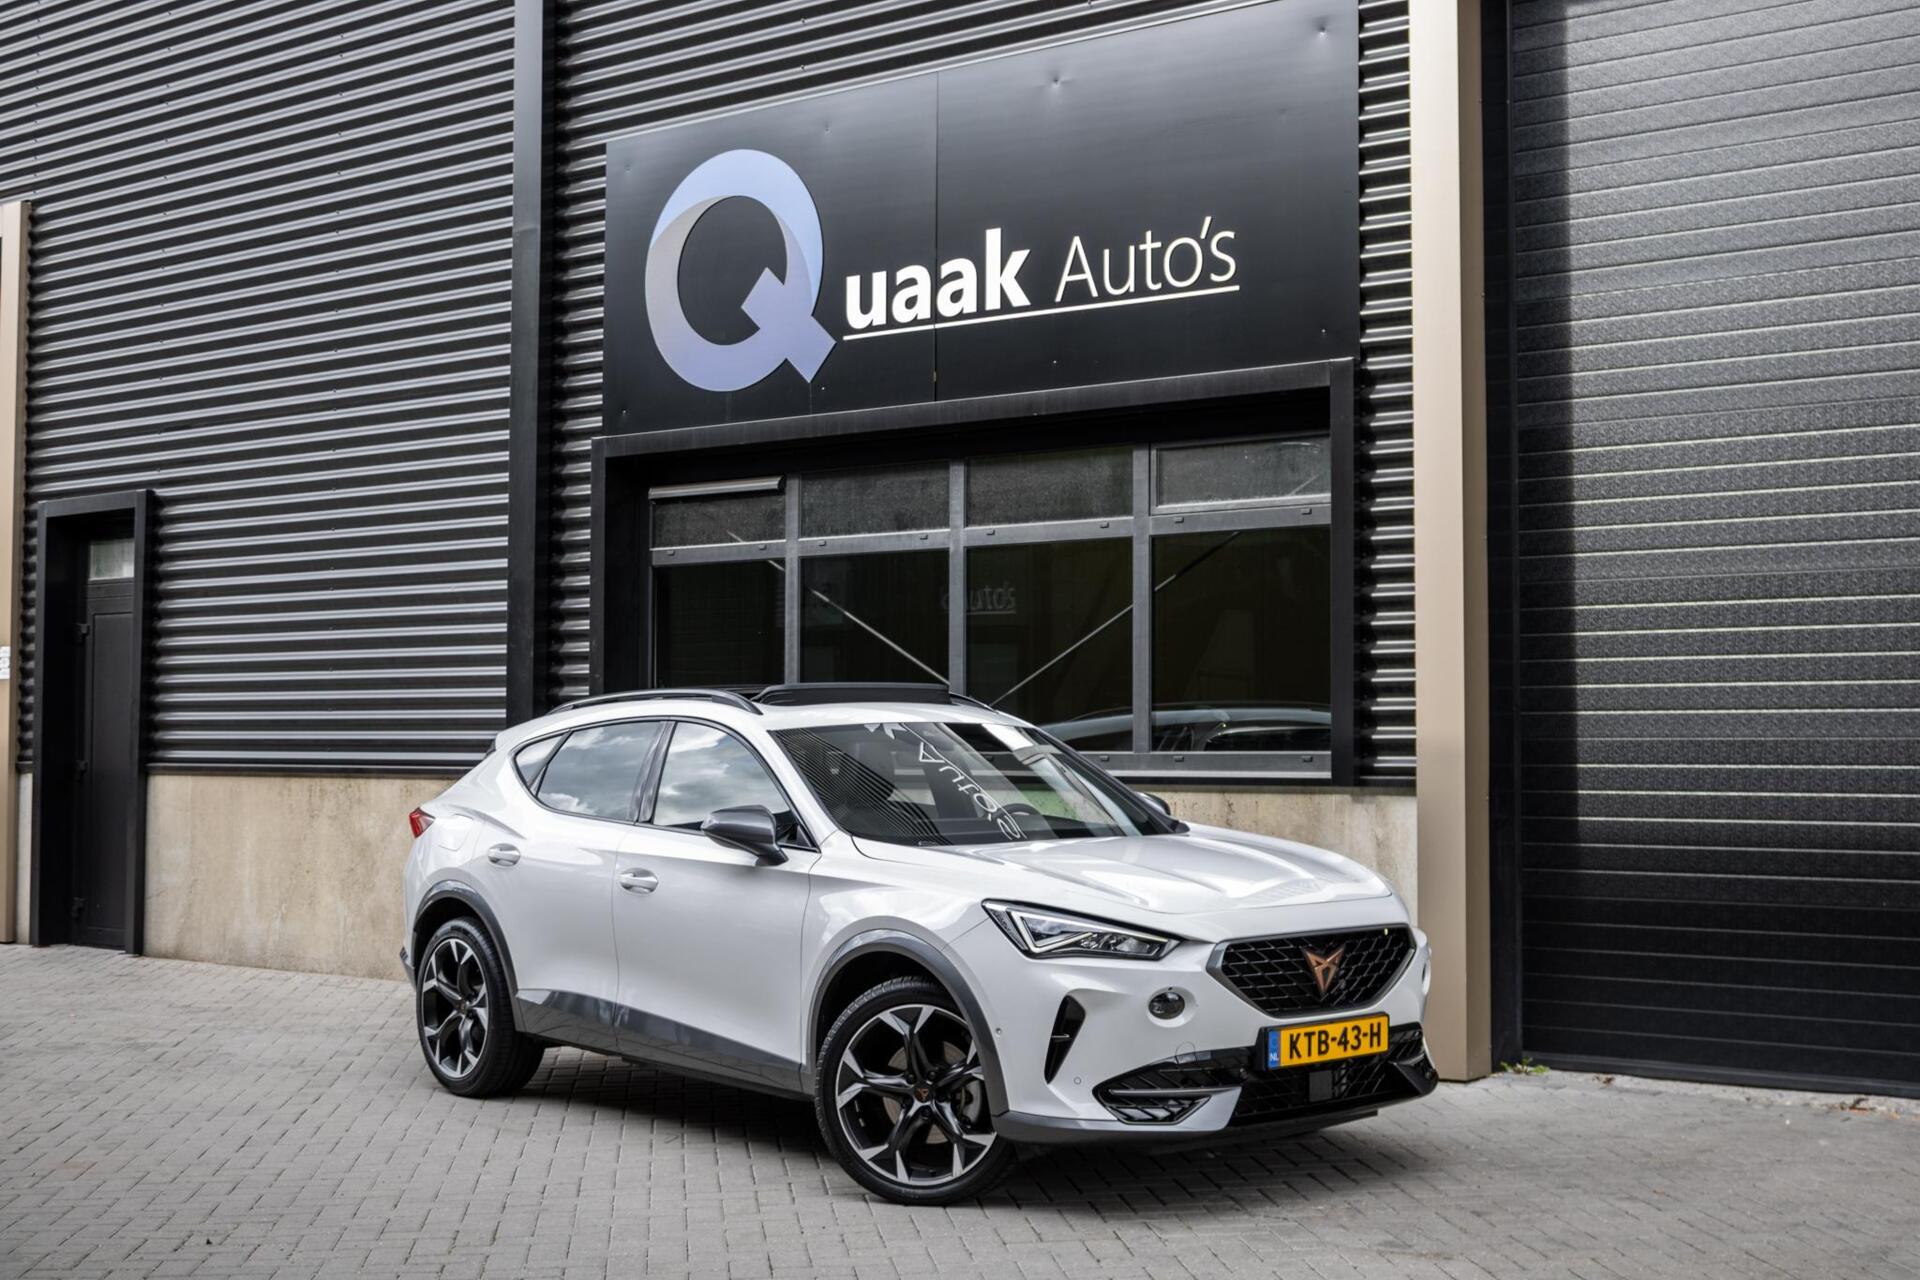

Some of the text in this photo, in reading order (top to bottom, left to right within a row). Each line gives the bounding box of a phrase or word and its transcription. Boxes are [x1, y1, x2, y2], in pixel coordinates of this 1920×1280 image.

[645, 148, 1239, 392] Quaak Auto's
[1269, 1053, 1279, 1061] NL
[1289, 1021, 1381, 1059] KTB-43-H
